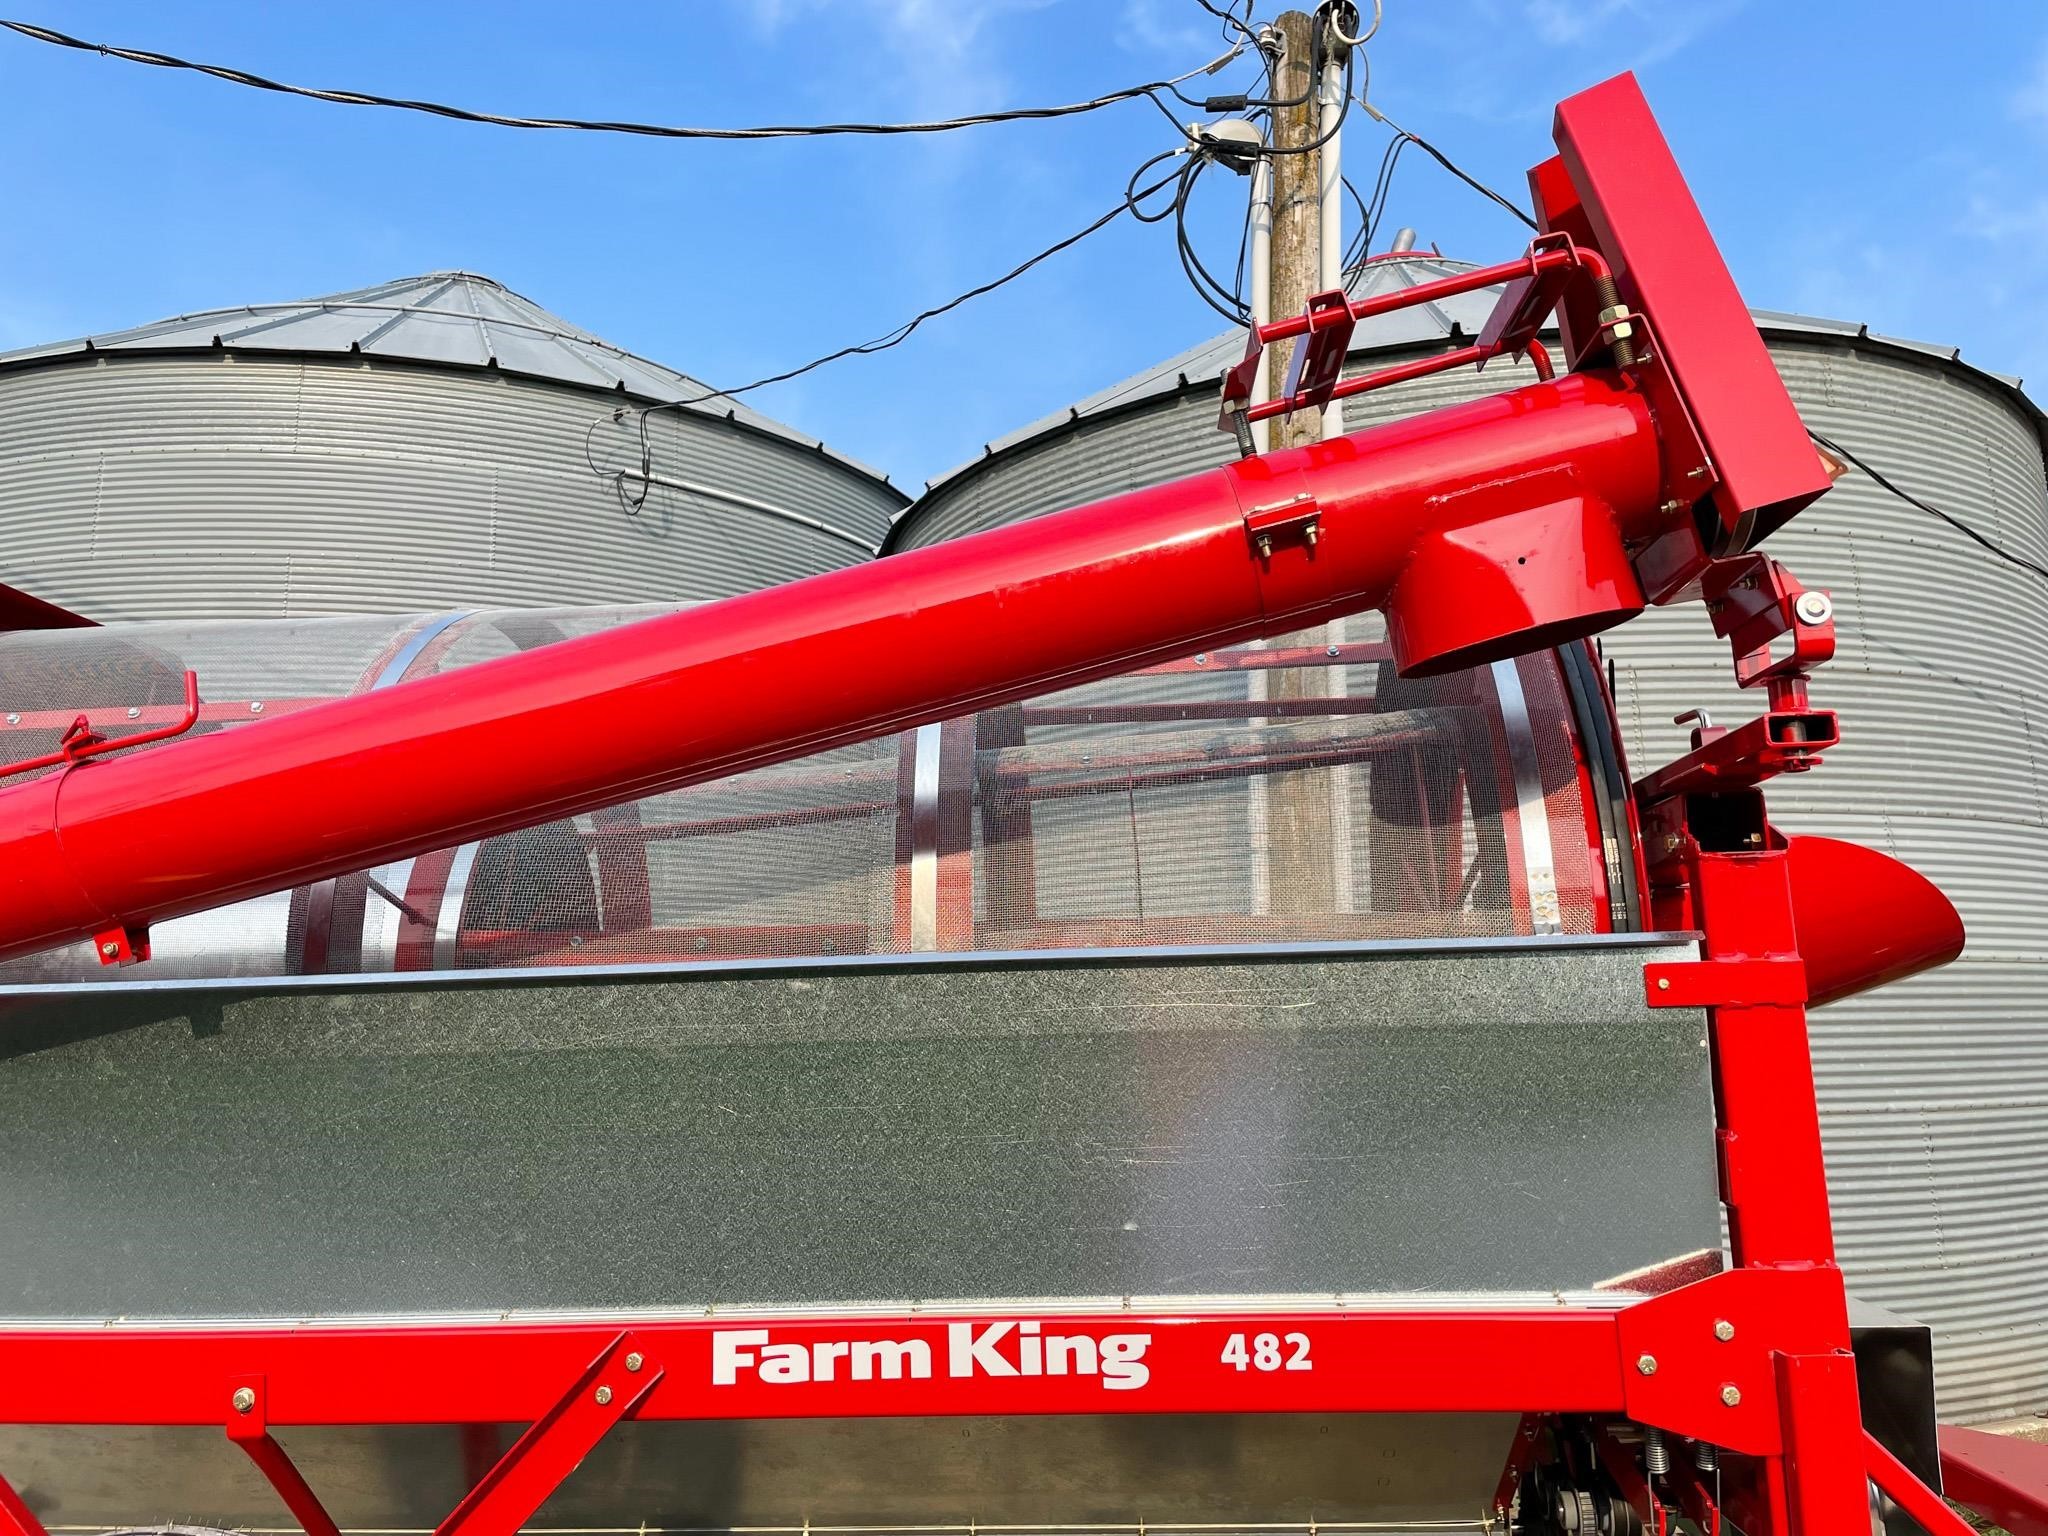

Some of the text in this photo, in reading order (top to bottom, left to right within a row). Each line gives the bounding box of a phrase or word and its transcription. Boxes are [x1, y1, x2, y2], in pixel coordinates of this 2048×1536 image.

[712, 1321, 1152, 1390] Farm King
[1220, 1332, 1313, 1372] 482
